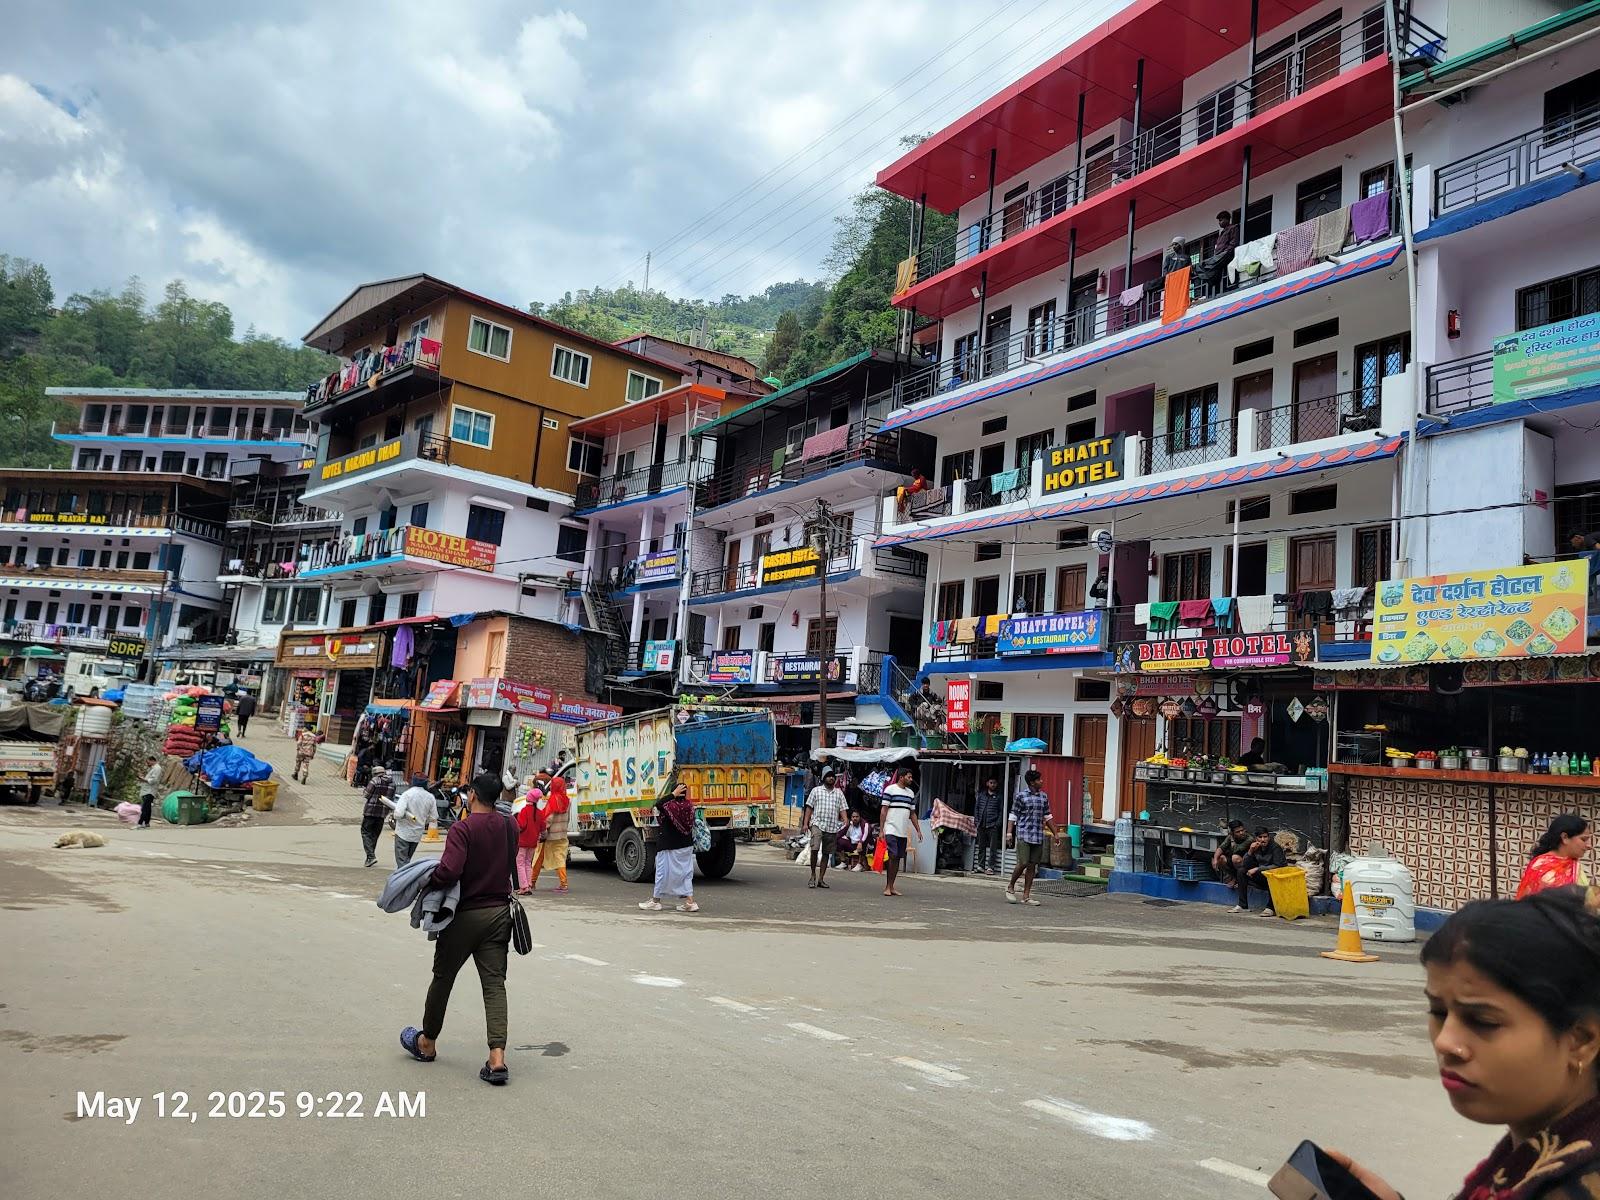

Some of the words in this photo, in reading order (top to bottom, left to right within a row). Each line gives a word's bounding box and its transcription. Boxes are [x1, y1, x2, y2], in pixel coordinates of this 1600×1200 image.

[1521, 332, 1536, 342] देव
[1540, 325, 1565, 337] दर्शन
[1567, 317, 1596, 332] होटल
[1555, 335, 1579, 346] गेस्ट
[1051, 438, 1113, 466] BHATT
[1045, 460, 1119, 491] HOTEL
[30, 513, 54, 522] HOTEL
[409, 527, 470, 554] HOTEL
[770, 564, 817, 581] RESTAURANT
[1410, 583, 1438, 604] देव
[1440, 577, 1487, 600] दर्शन
[1489, 574, 1545, 598] होटल
[1014, 619, 1048, 634] BHATT
[1049, 616, 1085, 632] HOTEL
[1026, 637, 1031, 645] &
[1032, 633, 1070, 645] RESTAURANT
[1138, 639, 1208, 661] BHATT
[1213, 634, 1292, 657] HOTEL
[110, 640, 145, 657] SDRF
[1140, 676, 1164, 684] BHATT
[1166, 675, 1192, 684] HOTEL
[948, 684, 969, 701] ROOMS
[954, 700, 964, 711] ARE
[1247, 704, 1262, 713] डिनर
[951, 720, 964, 729] HERE
[611, 759, 623, 787] A
[626, 757, 636, 785] S
